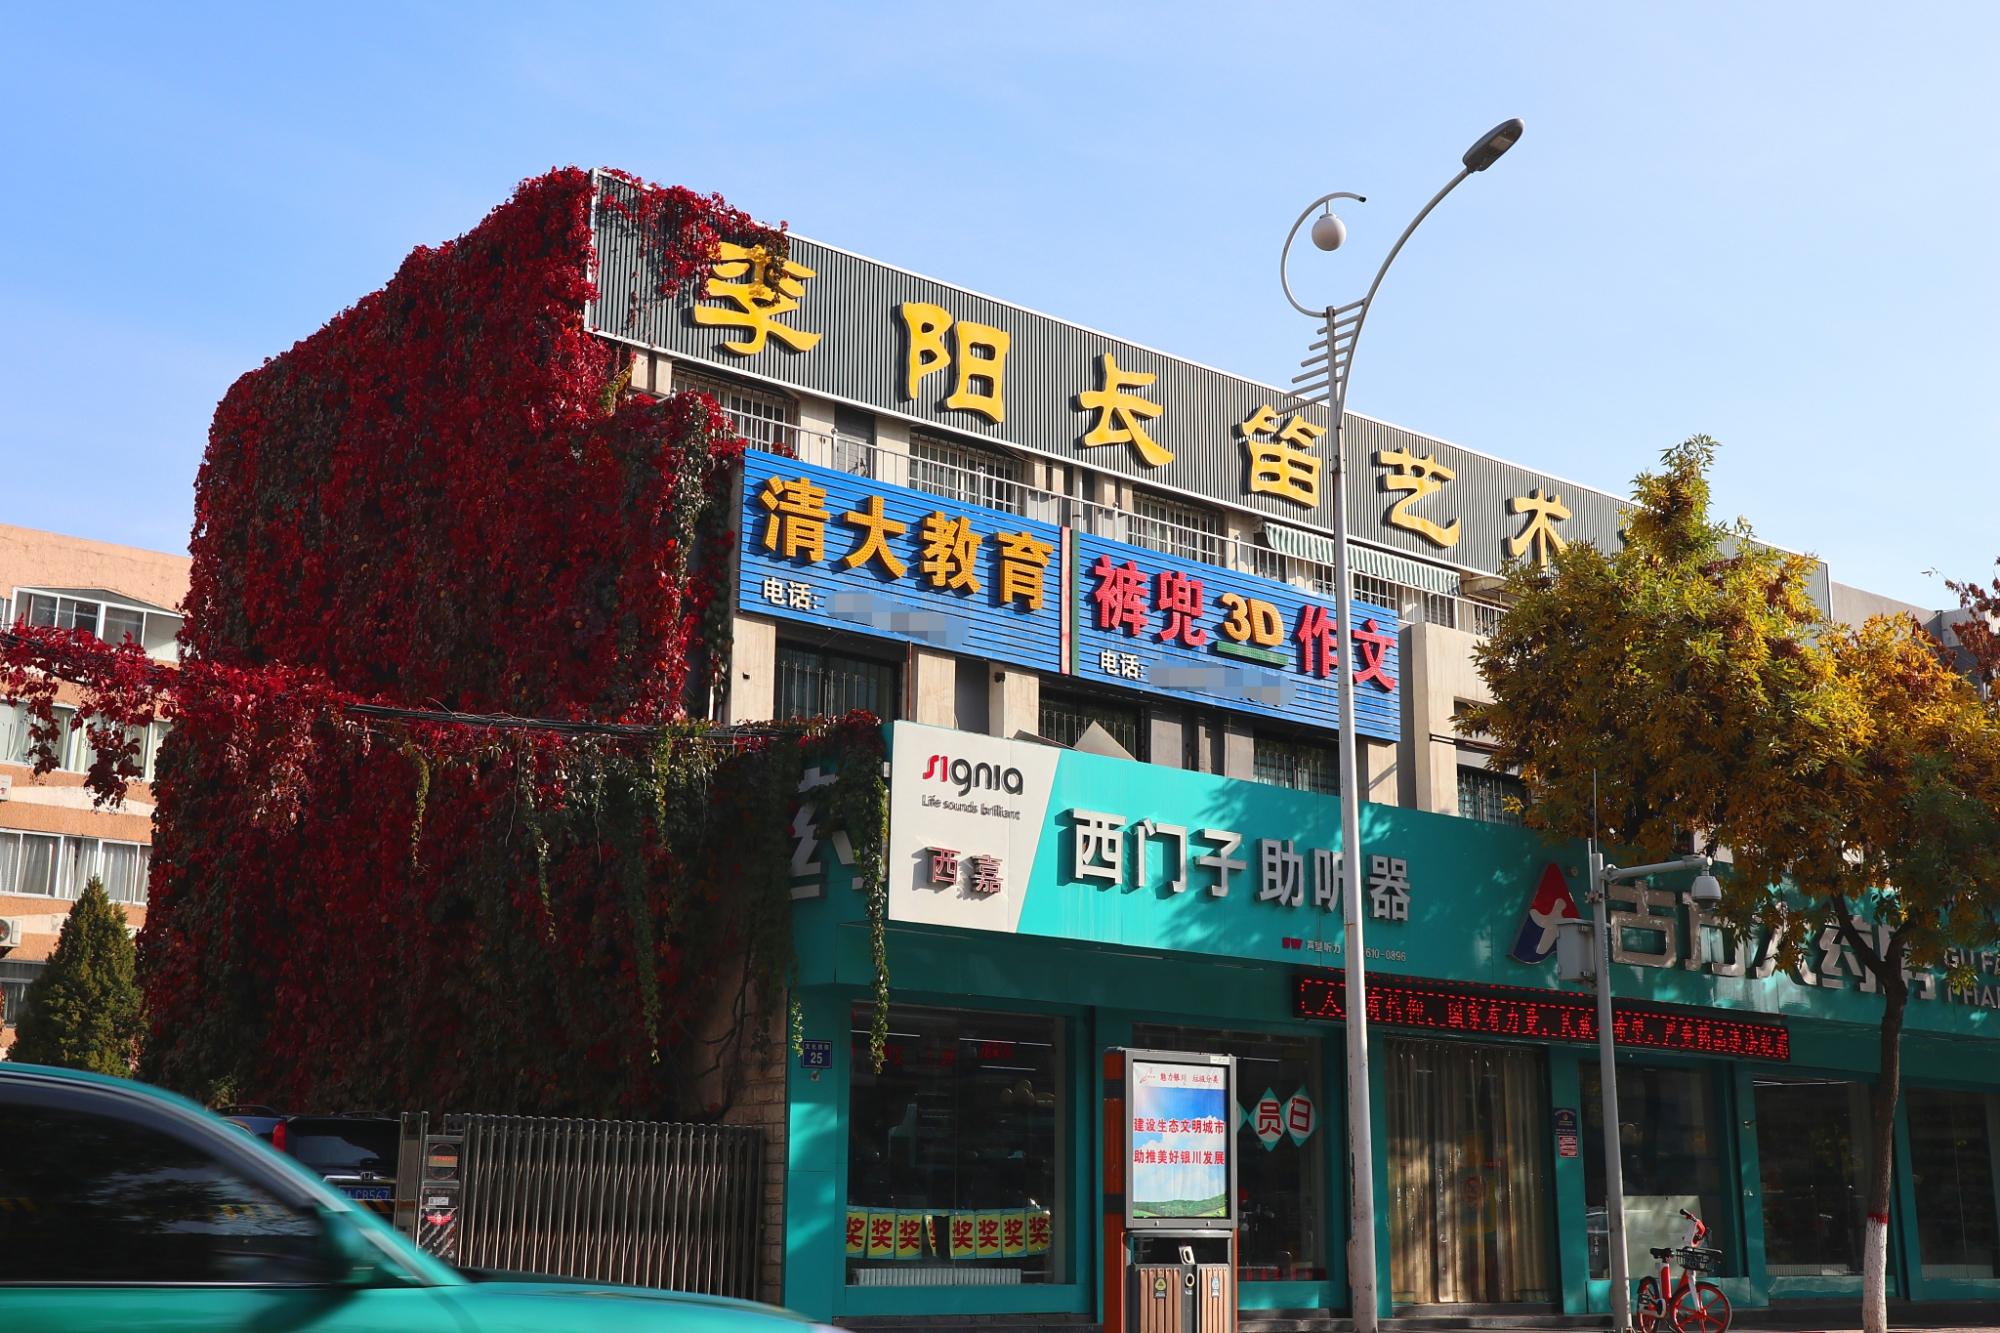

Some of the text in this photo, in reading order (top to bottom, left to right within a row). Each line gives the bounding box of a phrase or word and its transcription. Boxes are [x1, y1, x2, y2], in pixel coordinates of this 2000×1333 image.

[758, 475, 1055, 611] 清大教育
[1093, 554, 1397, 692] 裤兜3D作文
[922, 754, 1023, 797] signia
[921, 794, 1021, 820] Life sounds brilliant
[929, 846, 1004, 894] 西嘉
[1071, 808, 1411, 921] 西门子助听器
[810, 1051, 823, 1064] 25
[1133, 1117, 1225, 1135] 建设生态文明城市
[1133, 1150, 1225, 1166] 助推美好银川发展
[871, 1218, 893, 1249] 奖
[899, 1219, 921, 1250] 奖
[952, 1220, 974, 1249] 奖
[978, 1218, 999, 1249] 奖
[1003, 1218, 1024, 1248] 奖
[1028, 1216, 1049, 1245] 奖
